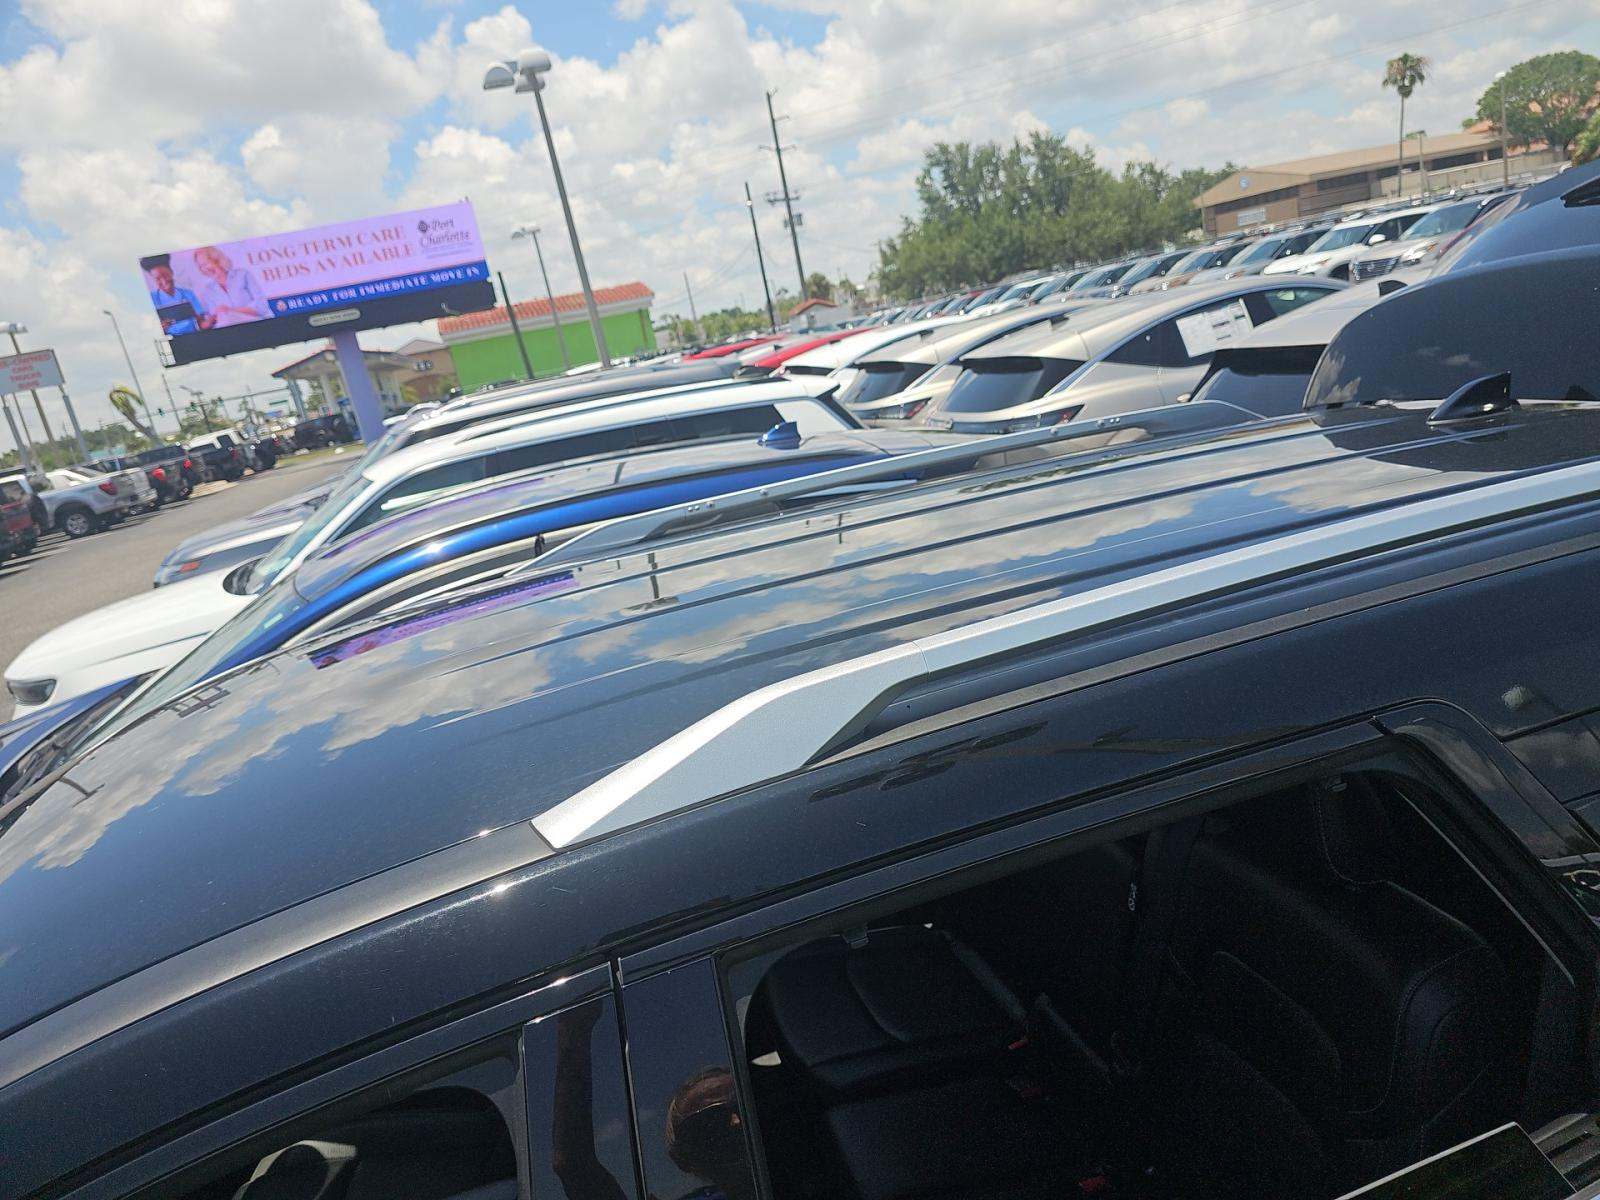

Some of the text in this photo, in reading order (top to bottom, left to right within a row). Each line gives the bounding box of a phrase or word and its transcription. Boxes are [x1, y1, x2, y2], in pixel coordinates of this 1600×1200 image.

[246, 225, 407, 266] LONG TERM CARE
[262, 262, 311, 282] BEDS
[316, 243, 414, 273] AVAILABLE
[287, 293, 328, 310] READY
[332, 288, 357, 301] FOR
[359, 275, 427, 297] IMMEDIATE
[430, 268, 464, 283] MOVE
